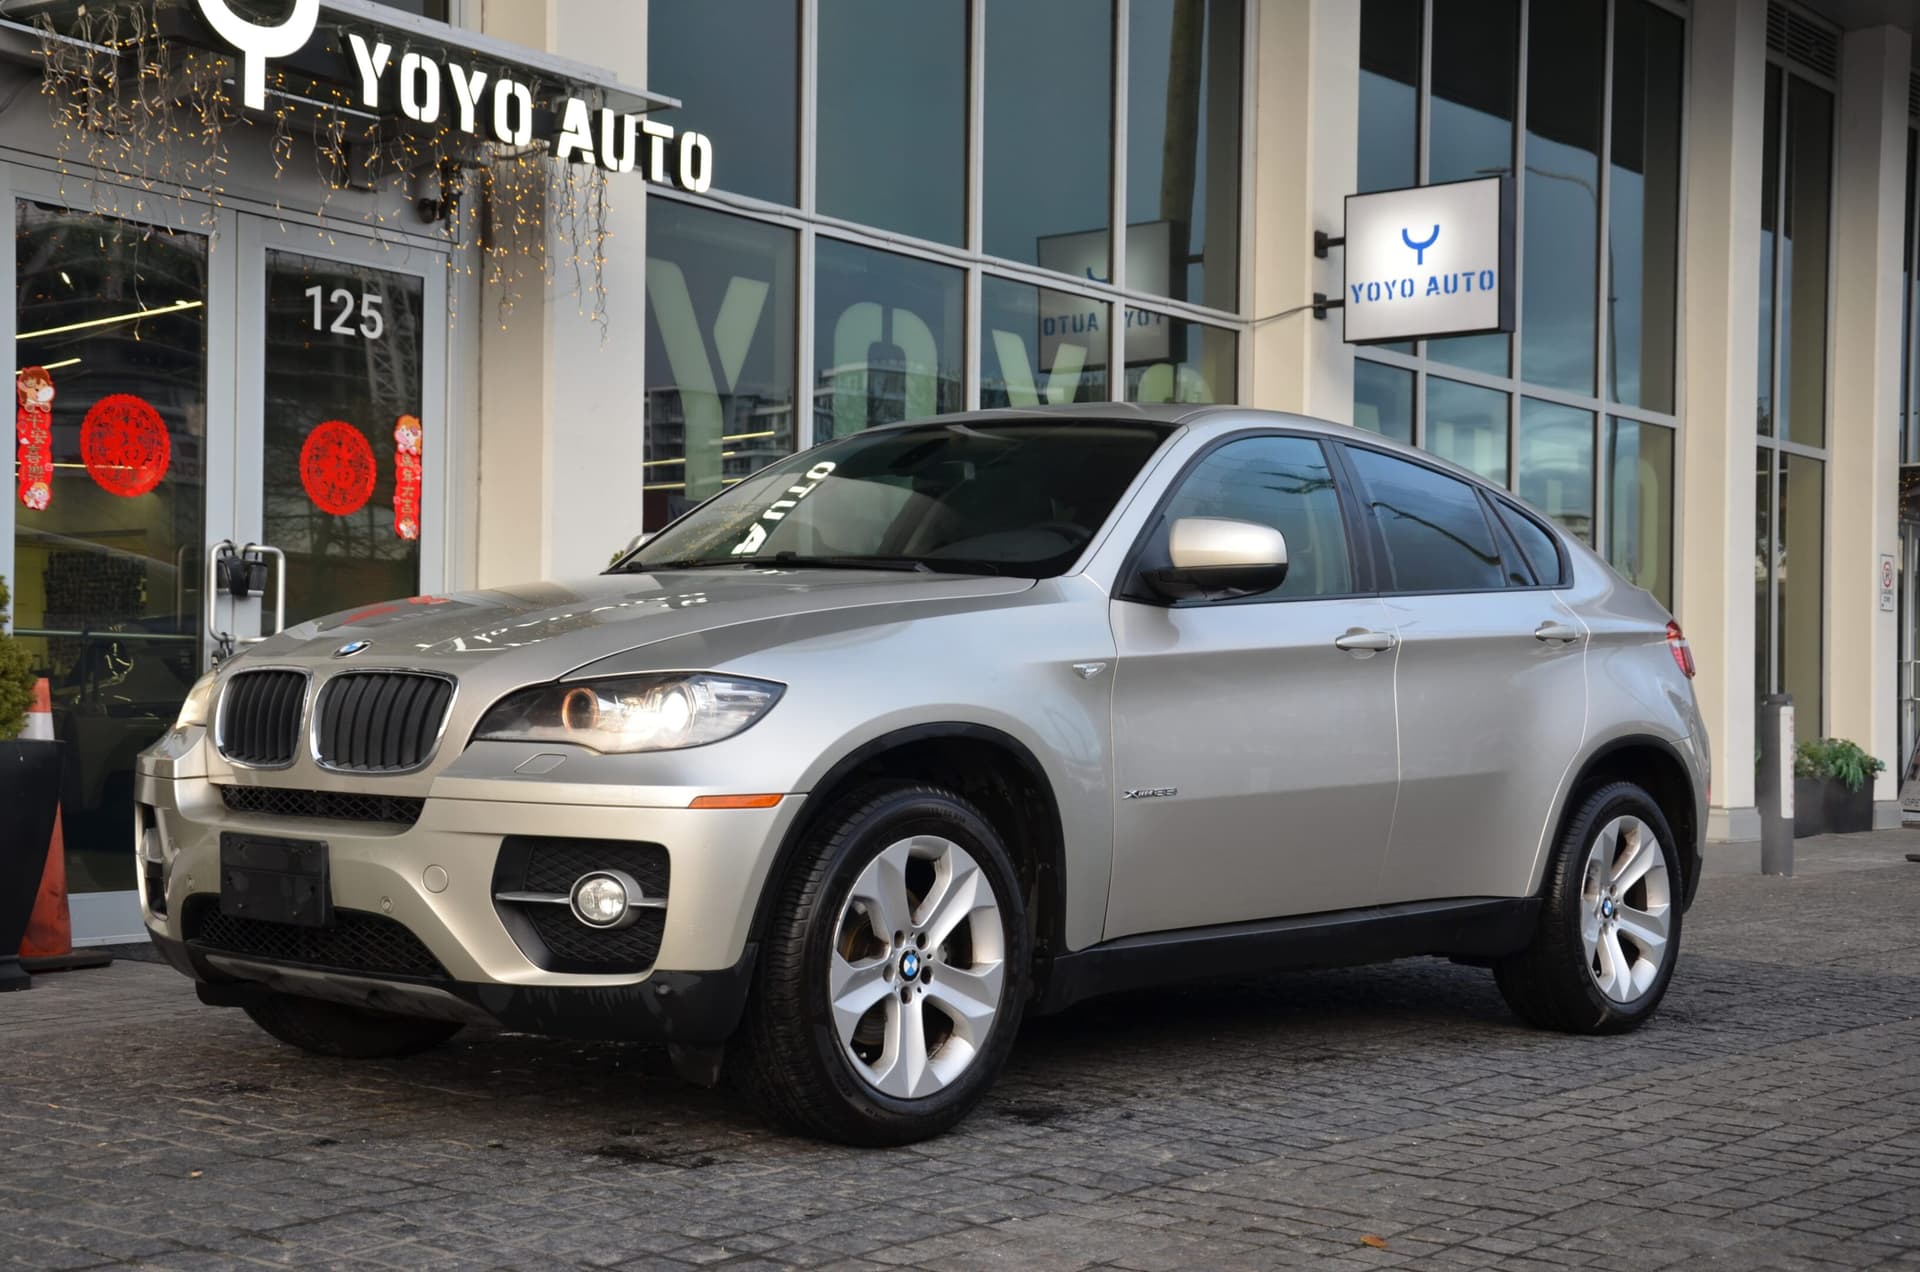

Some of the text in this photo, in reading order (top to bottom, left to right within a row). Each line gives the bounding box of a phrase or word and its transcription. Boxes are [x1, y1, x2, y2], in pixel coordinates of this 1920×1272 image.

[349, 33, 713, 193] YOYO AUTO
[305, 285, 384, 340] 125
[1351, 269, 1495, 304] YOYO AUTO
